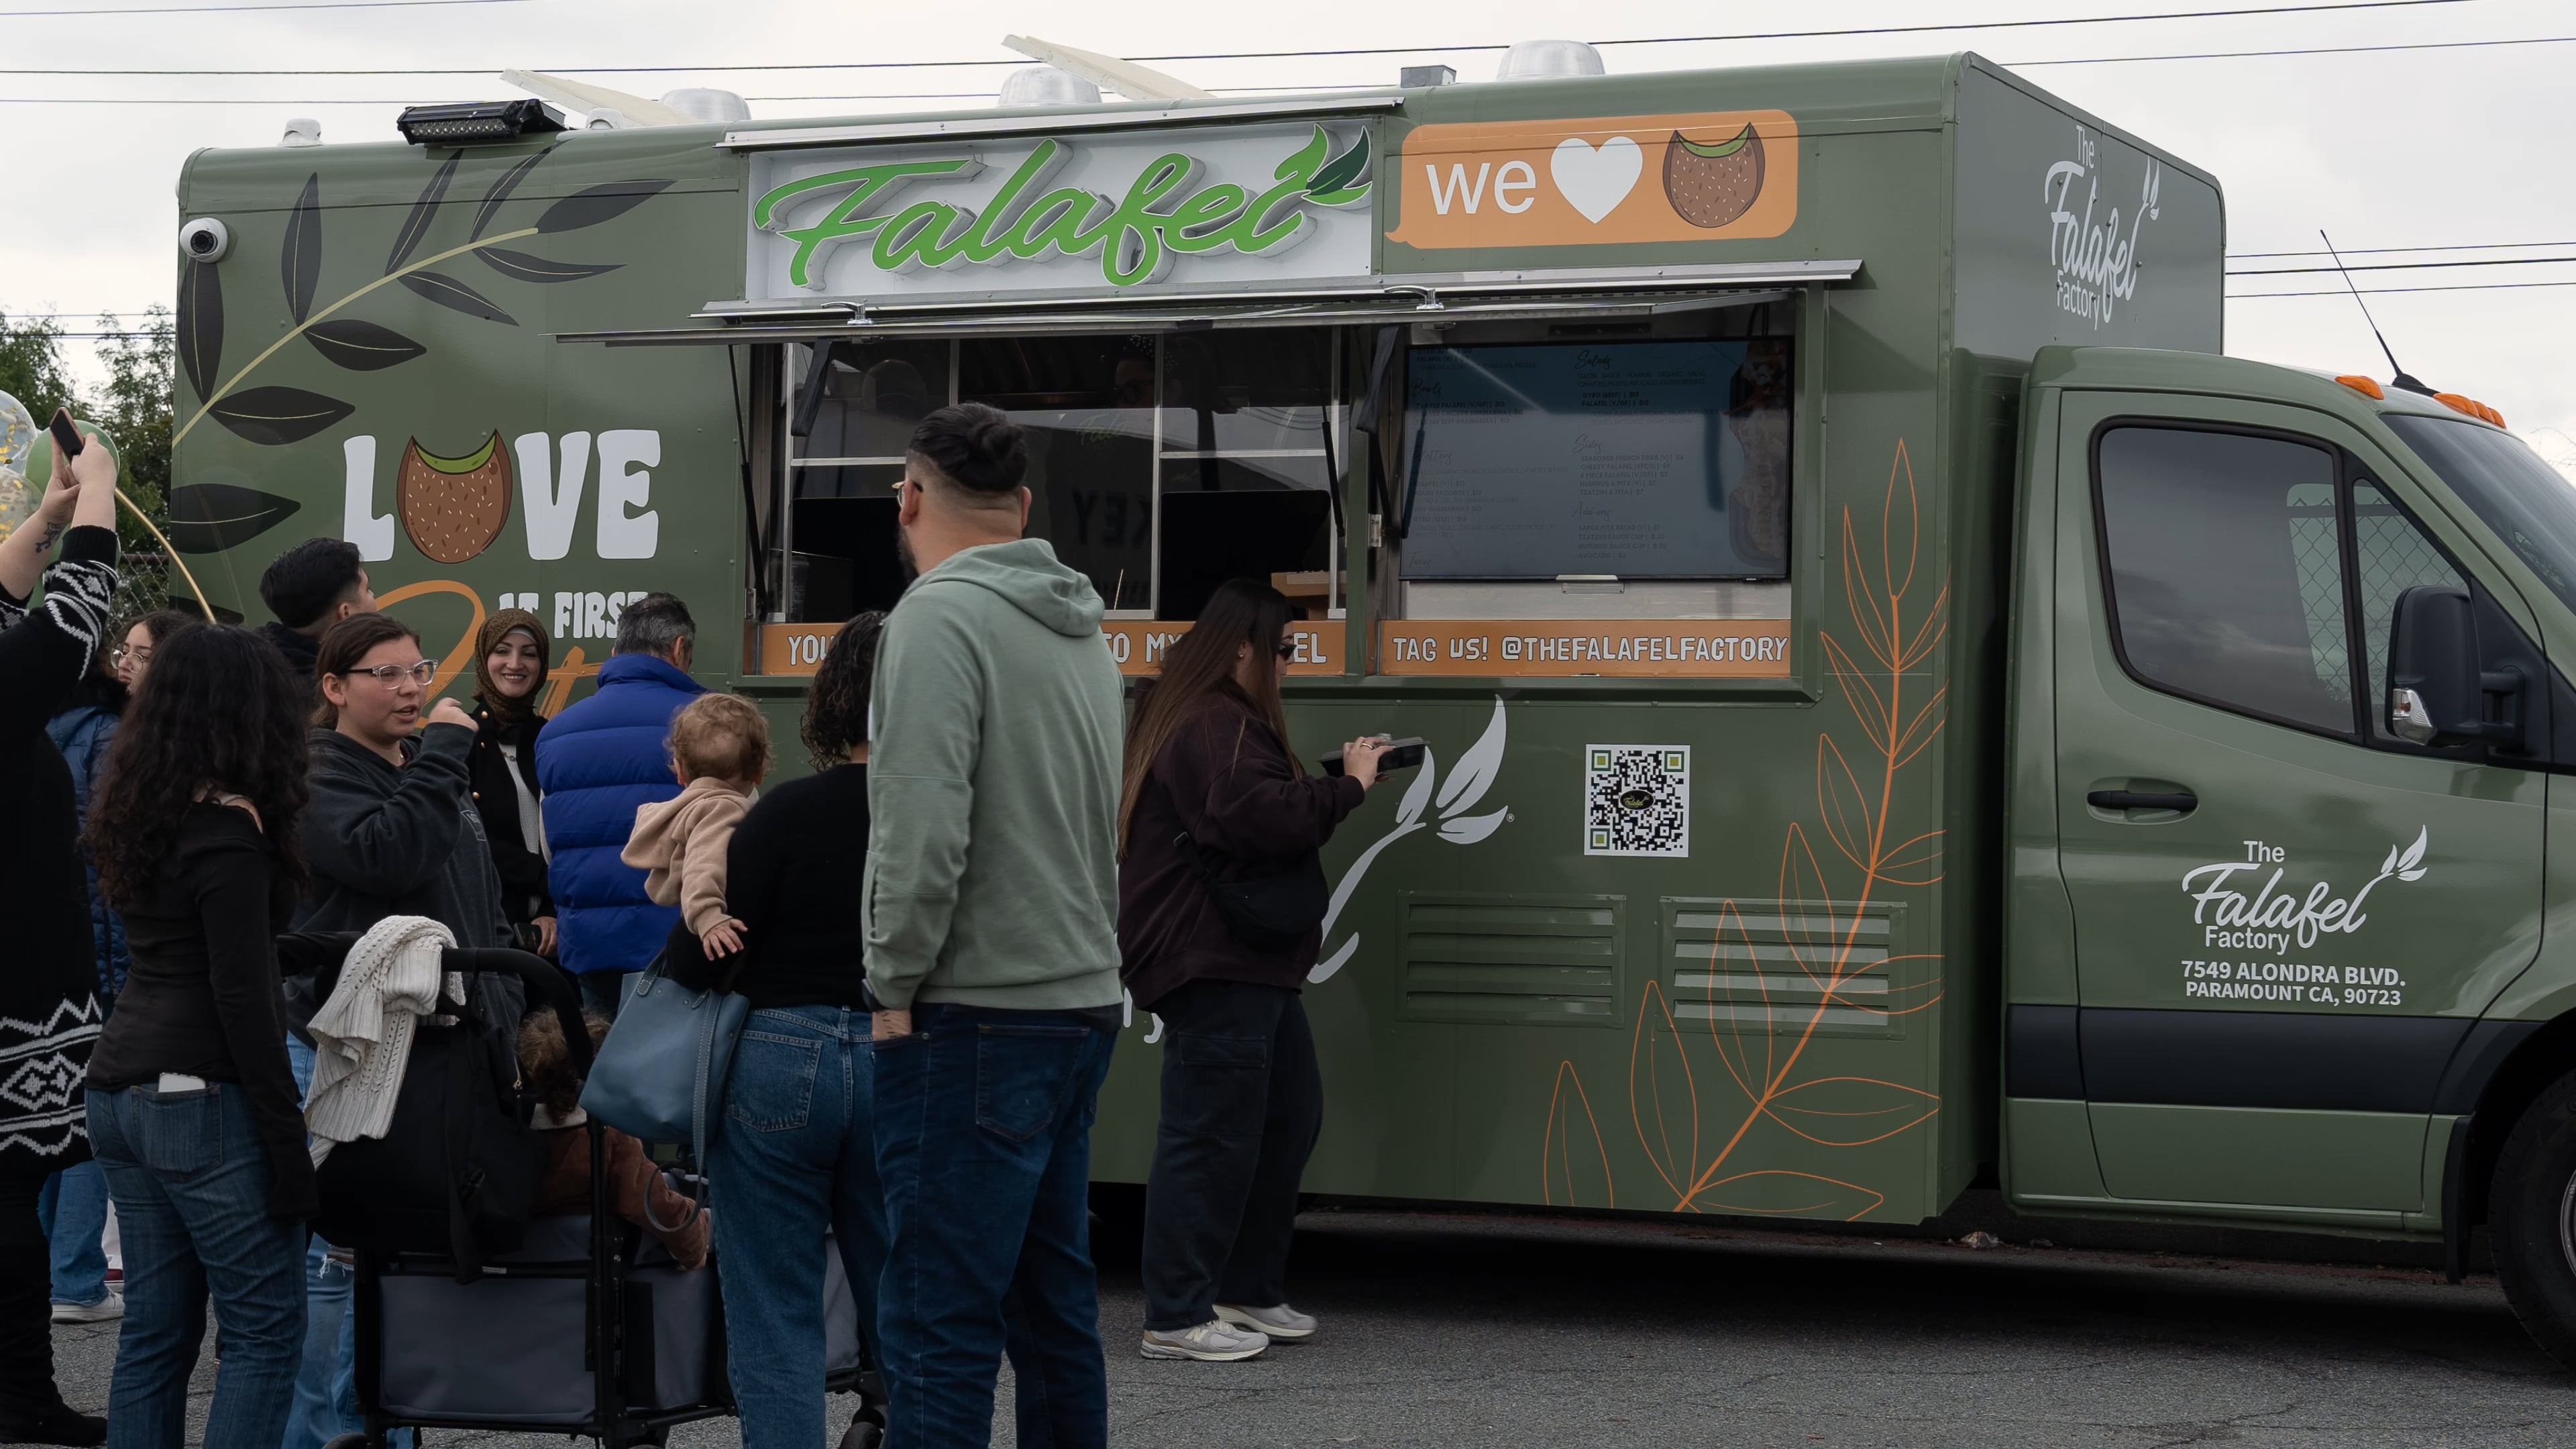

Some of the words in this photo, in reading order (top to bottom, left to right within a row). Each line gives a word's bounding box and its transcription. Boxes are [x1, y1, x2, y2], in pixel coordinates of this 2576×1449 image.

[2076, 125, 2095, 169] The
[1425, 159, 1537, 215] we
[753, 125, 1372, 288] Falafel
[2044, 158, 2155, 324] Falafel
[2056, 269, 2100, 331] Factory
[1572, 433, 1605, 454] Sides
[1392, 637, 1437, 662] TAG
[1448, 636, 1489, 661] US!
[1501, 634, 1790, 663] @THEFALAFELFACTORY
[2243, 841, 2286, 863] The
[2182, 862, 2394, 949] Falafel
[2205, 925, 2290, 956] Factory
[2181, 960, 2232, 979] 7549
[2236, 961, 2340, 984] ALONDRA
[2345, 965, 2407, 987] BLVD.
[2186, 981, 2304, 1002] PARAMOUNT
[2308, 985, 2340, 1007] CA,
[2344, 987, 2402, 1006] 90723
